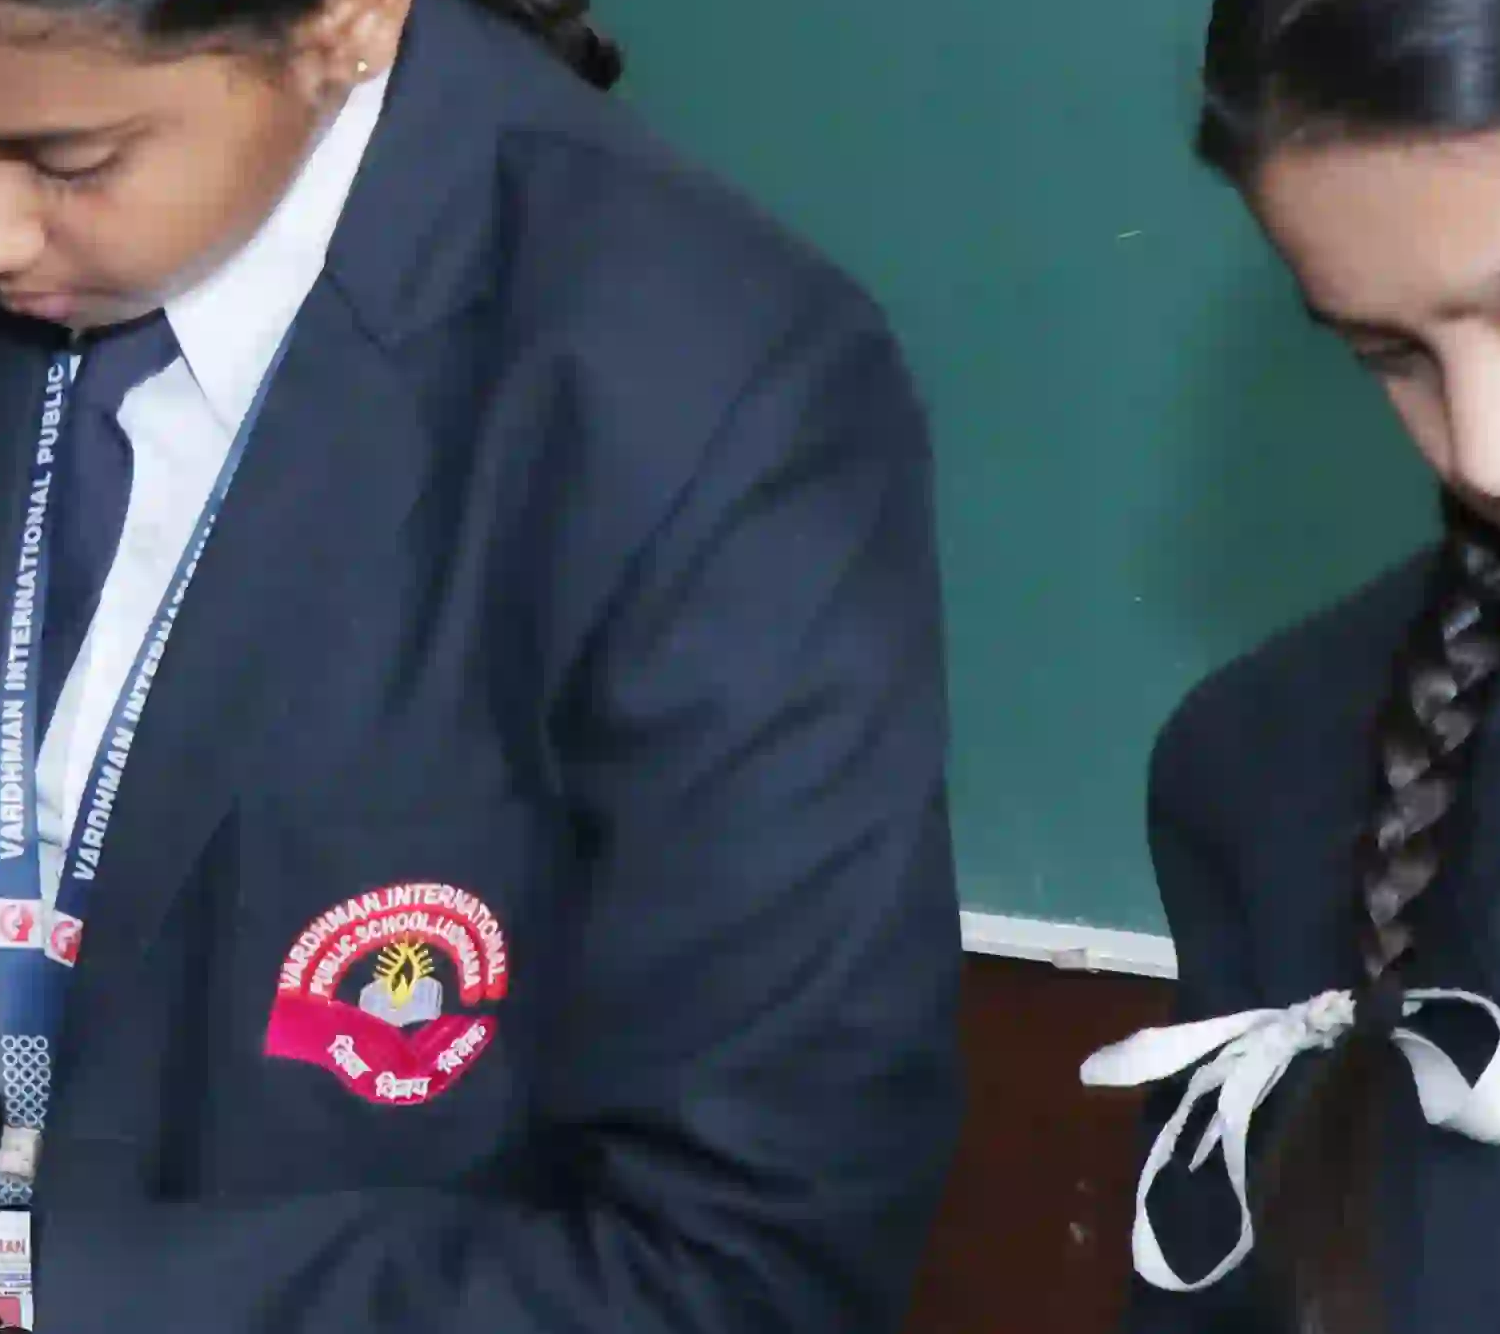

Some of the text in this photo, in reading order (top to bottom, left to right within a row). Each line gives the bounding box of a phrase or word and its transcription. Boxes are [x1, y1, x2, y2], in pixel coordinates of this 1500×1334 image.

[0, 362, 65, 861] VARDHMAN INTERNATIONAL PUBLIC
[73, 728, 134, 882] VARDHMAN
